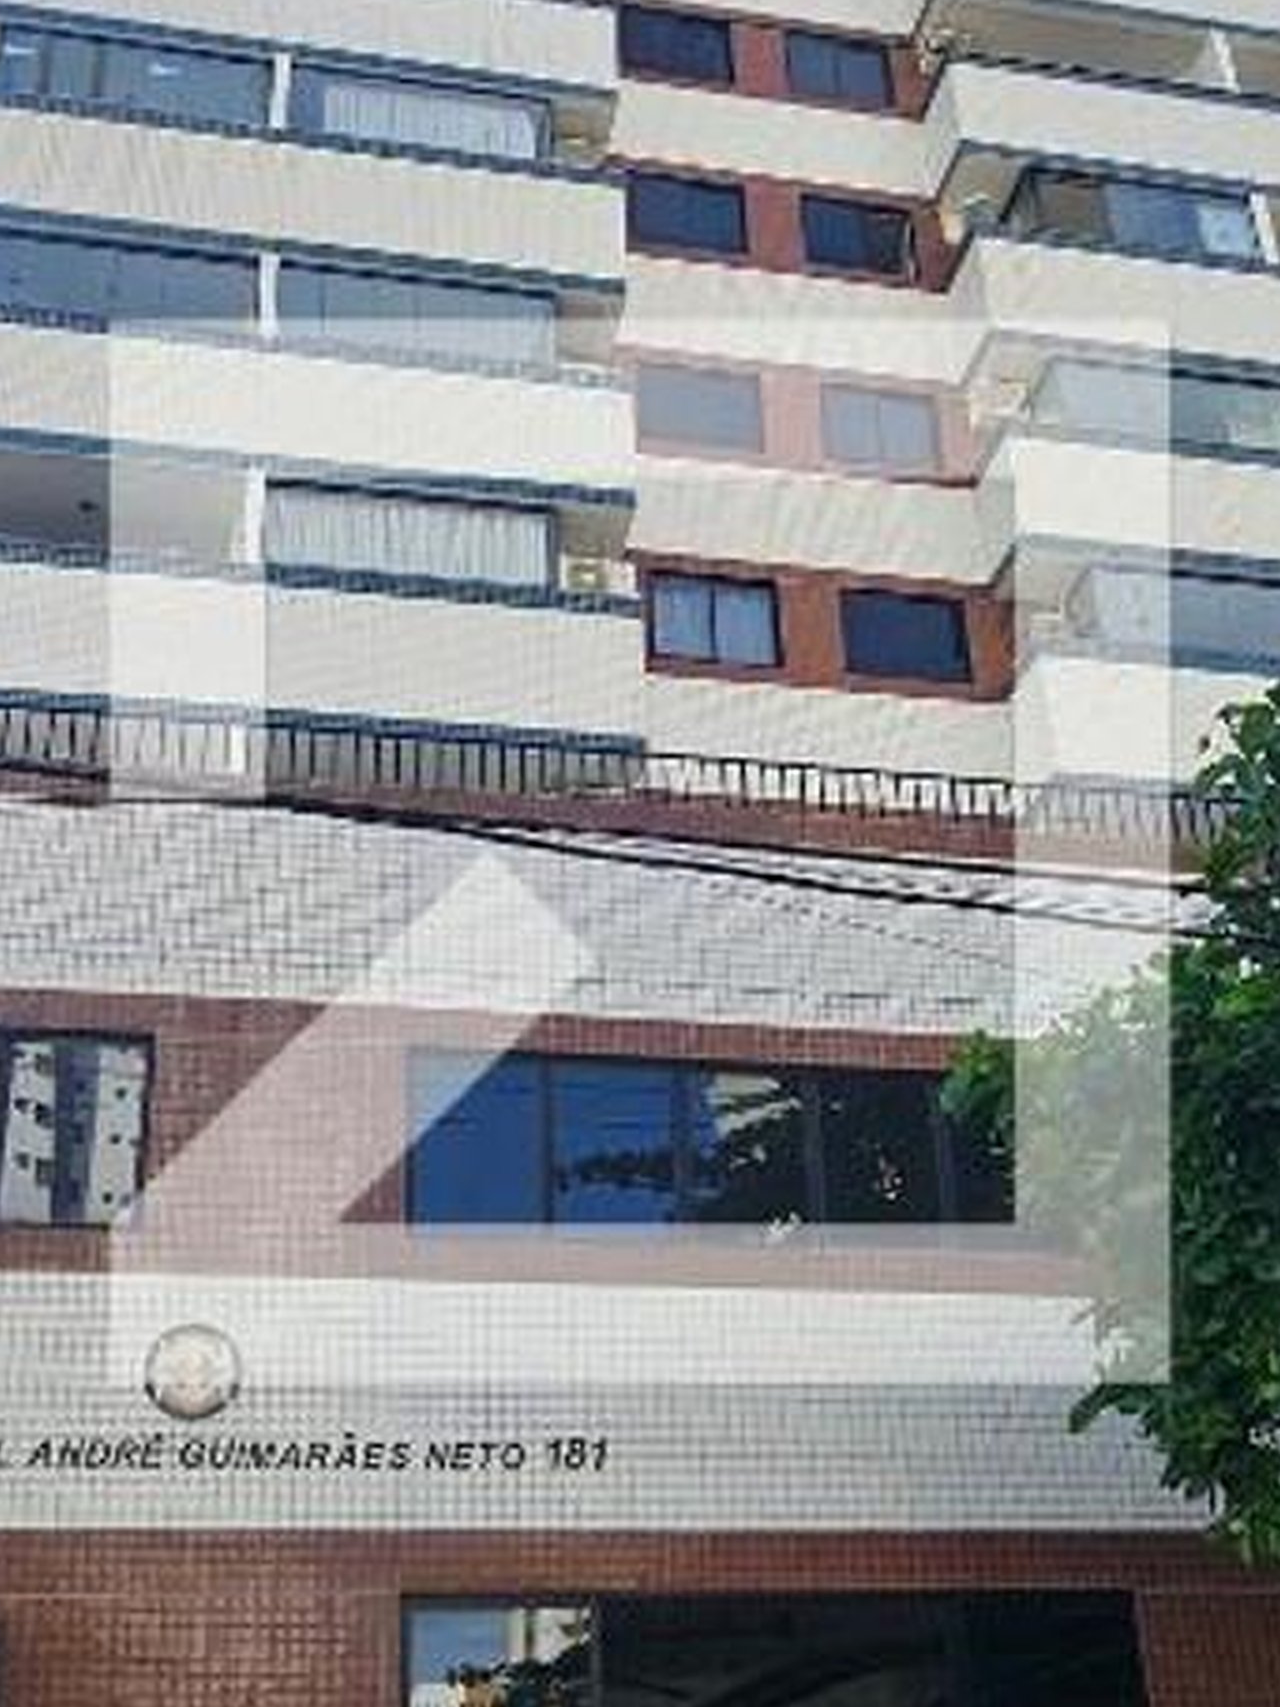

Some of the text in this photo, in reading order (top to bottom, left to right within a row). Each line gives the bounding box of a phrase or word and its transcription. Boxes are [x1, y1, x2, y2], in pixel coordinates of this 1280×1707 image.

[27, 1432, 165, 1470] ANDRÉ
[176, 1432, 413, 1471] GUIMARÃES
[424, 1441, 526, 1472] NETO
[545, 1436, 608, 1472] 181
